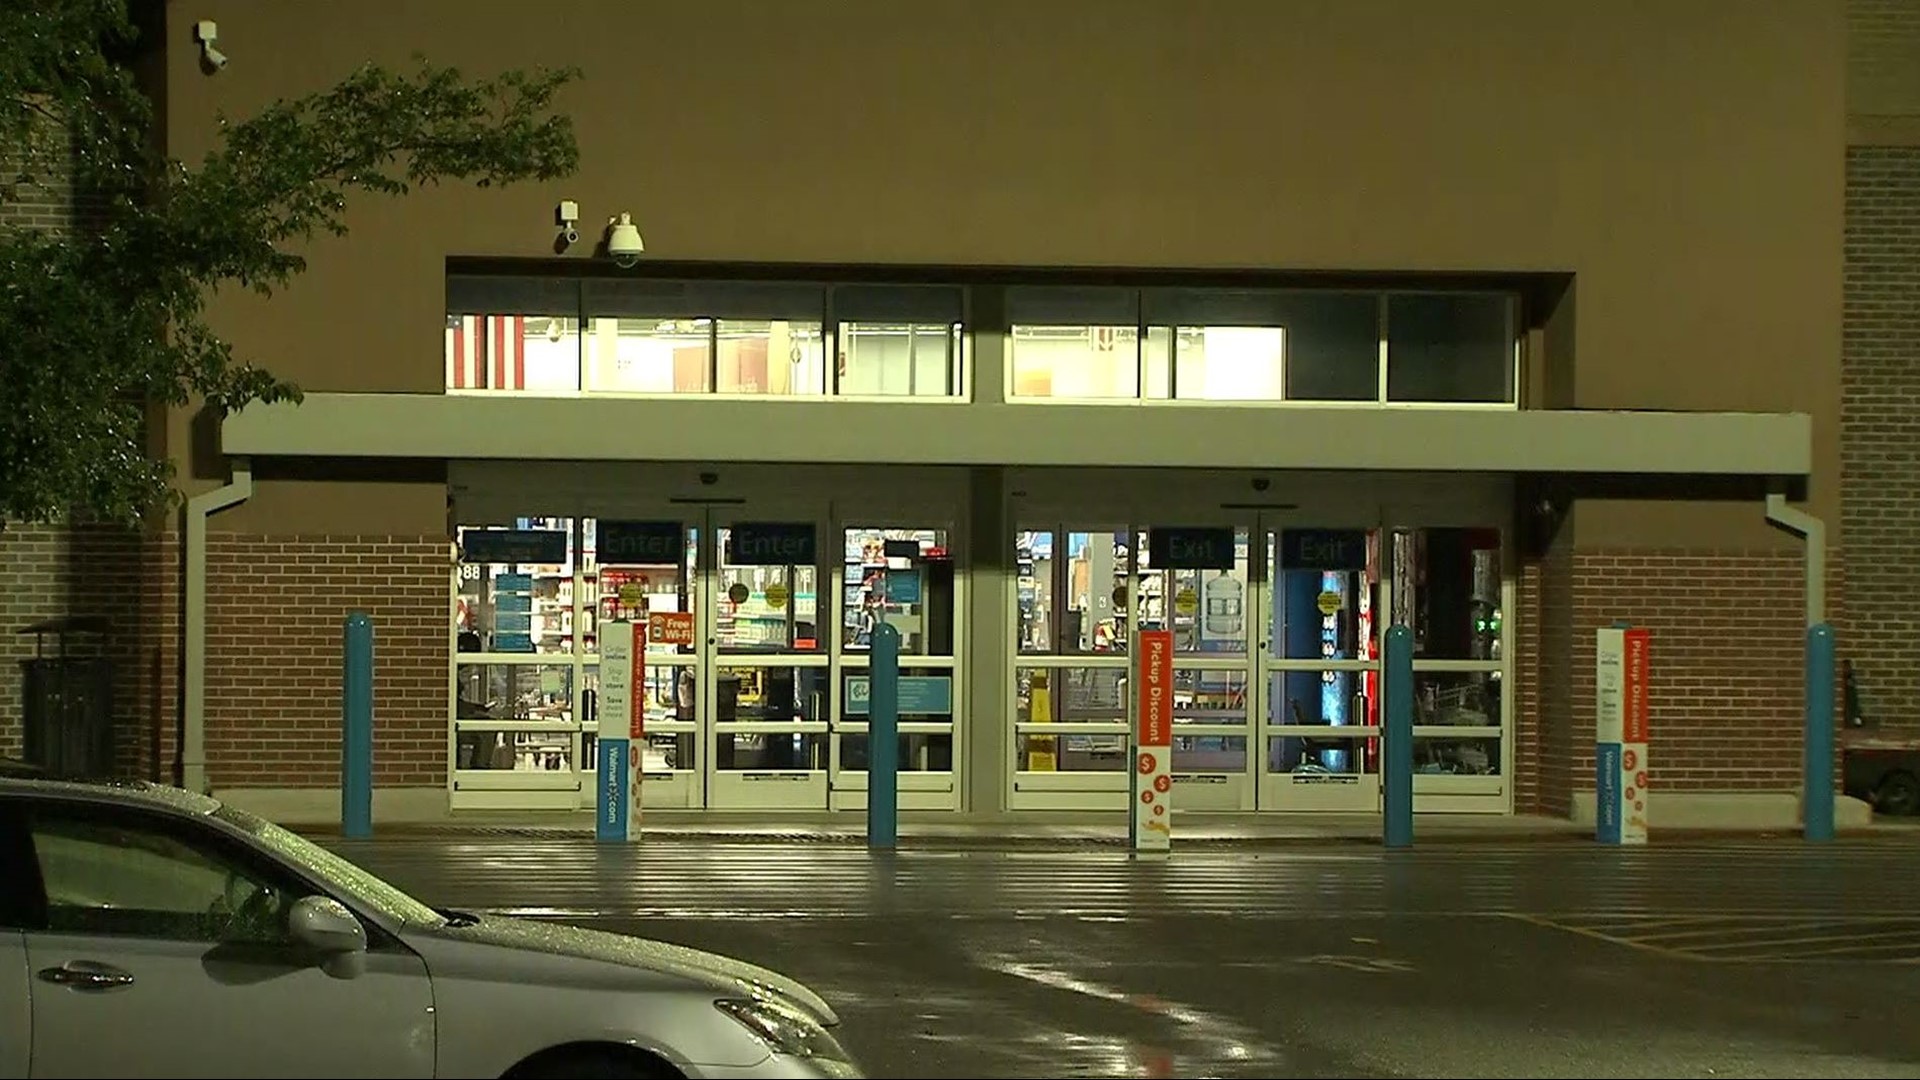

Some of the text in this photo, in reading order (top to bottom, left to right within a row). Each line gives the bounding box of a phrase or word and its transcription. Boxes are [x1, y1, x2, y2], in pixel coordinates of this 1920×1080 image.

[605, 532, 674, 554] Enter
[738, 531, 809, 555] Enter
[1169, 535, 1213, 560] Exit
[1300, 535, 1346, 560] Exit
[665, 629, 691, 640] Wi-Fi
[666, 618, 690, 628] Free
[1149, 642, 1163, 684] Pickup
[1630, 640, 1641, 681] Pickup
[1149, 687, 1163, 743] Discount
